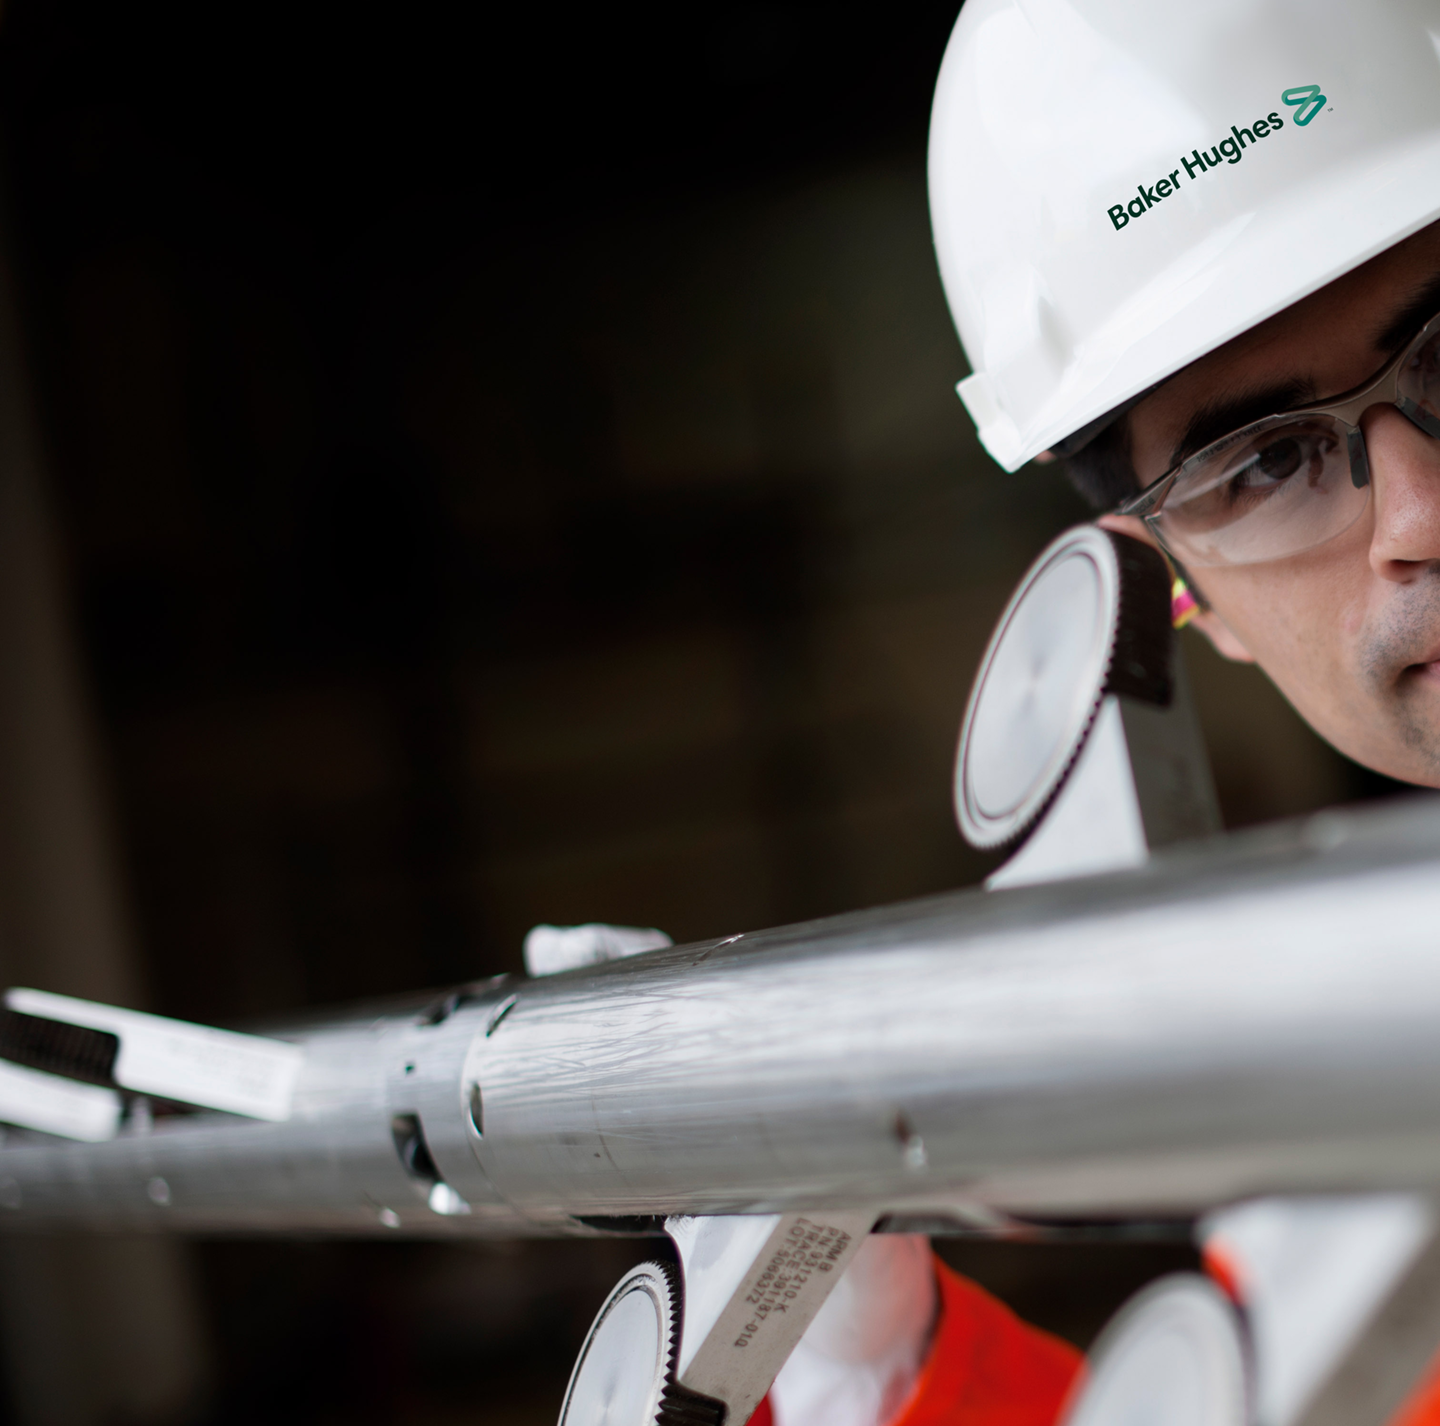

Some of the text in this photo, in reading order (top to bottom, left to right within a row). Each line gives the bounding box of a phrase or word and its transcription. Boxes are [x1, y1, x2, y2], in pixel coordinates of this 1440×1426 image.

[1106, 112, 1284, 231] Baker Hughes
[818, 1230, 852, 1272] ARM B
